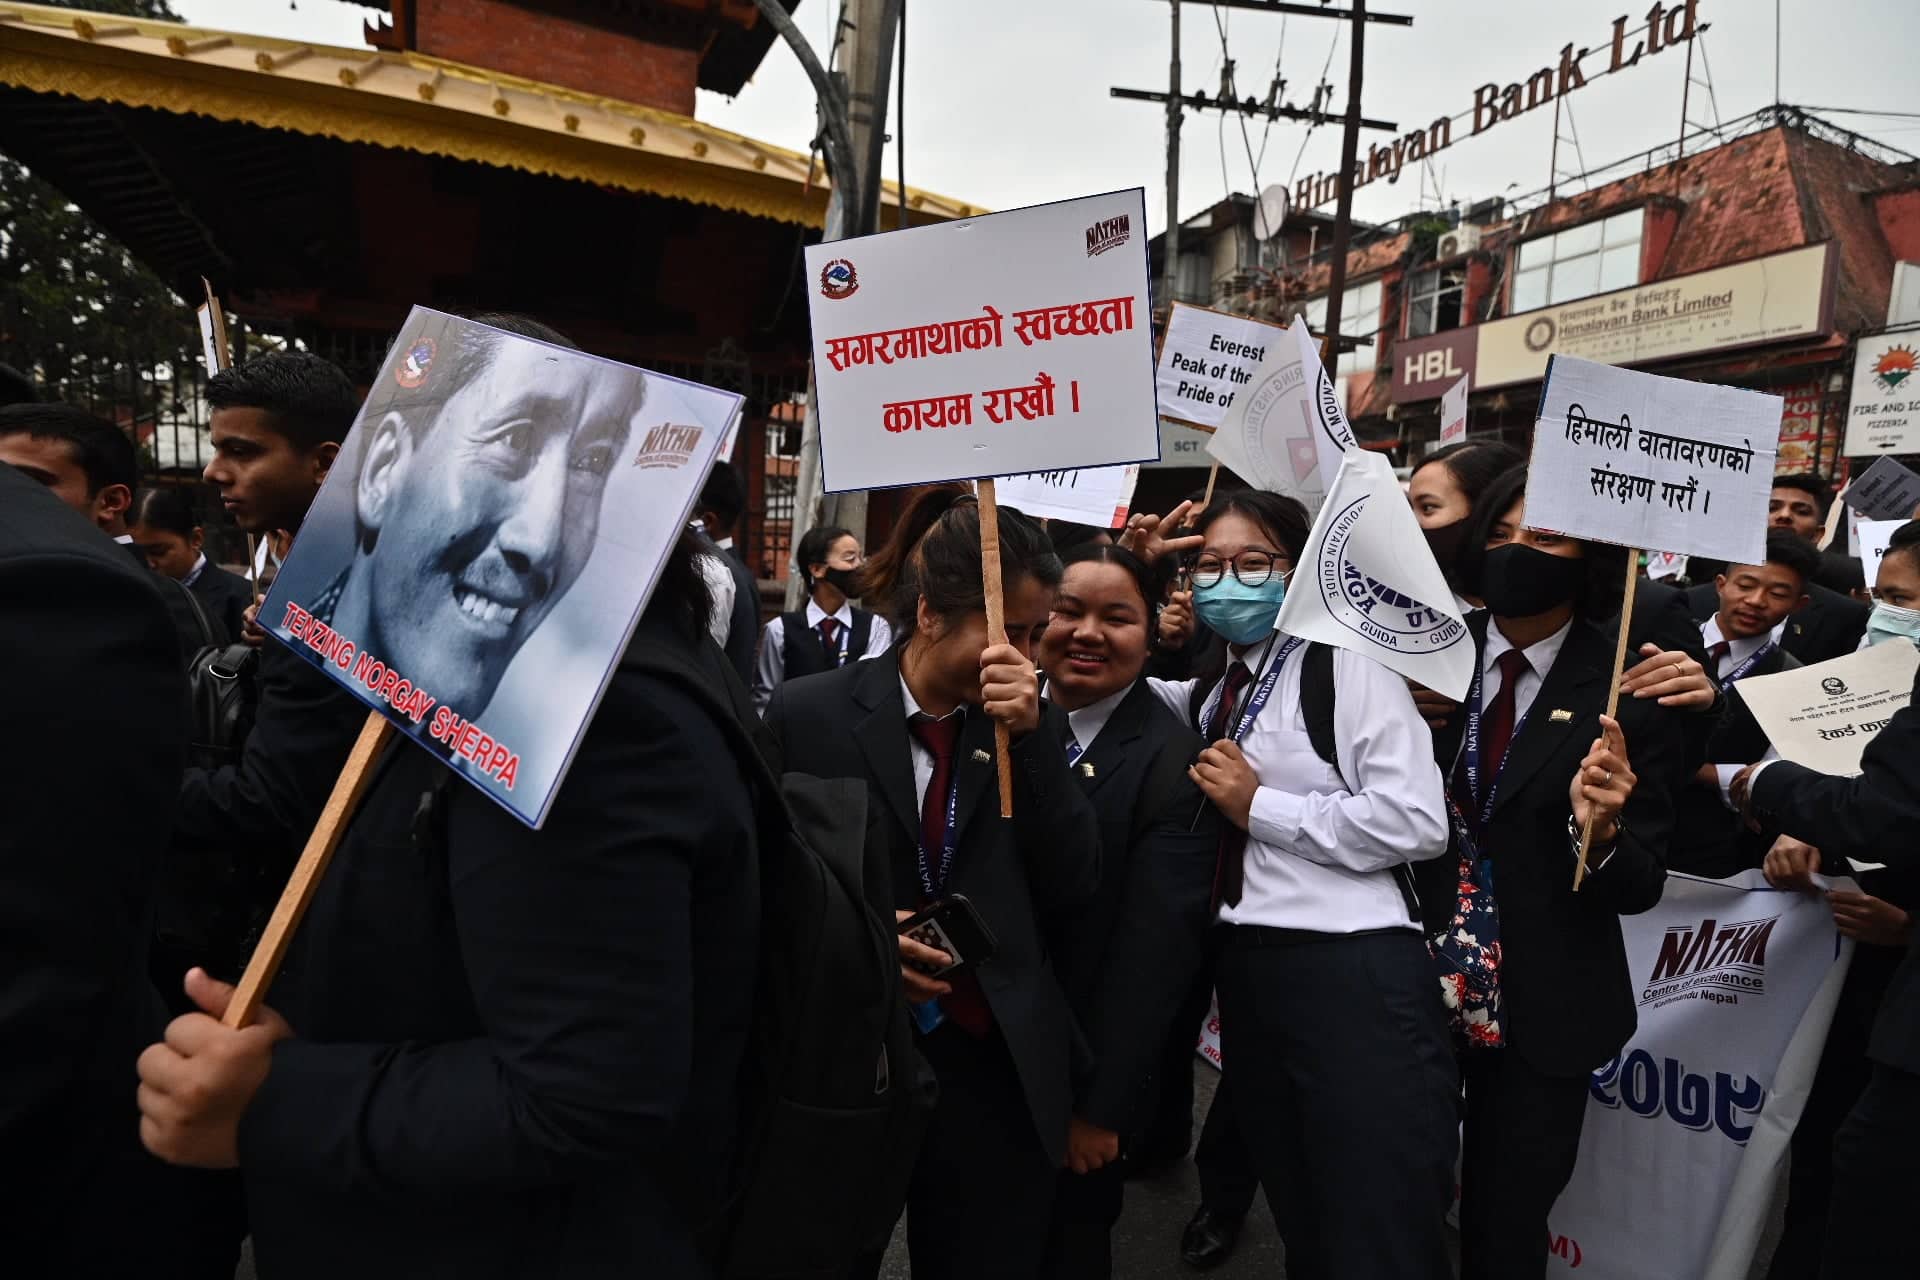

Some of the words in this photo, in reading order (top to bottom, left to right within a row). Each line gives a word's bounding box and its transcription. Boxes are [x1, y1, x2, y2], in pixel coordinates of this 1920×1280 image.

[1295, 116, 1452, 213] Himalayan
[1471, 42, 1589, 135] Bank
[1086, 214, 1129, 248] NATHM
[1559, 314, 1628, 337] Himalayan
[1631, 304, 1669, 323] Bank
[1673, 290, 1733, 314] Limited
[825, 305, 1003, 371] सगरमाथाको
[1012, 296, 1135, 346] स्वच्छता
[1209, 334, 1266, 362] Everest
[1171, 352, 1207, 375] Peak
[1211, 363, 1228, 380] of
[1404, 347, 1463, 385] HBL
[1177, 381, 1215, 403] Pride
[1218, 392, 1235, 408] of
[1853, 403, 1879, 416] FIRE
[1881, 402, 1905, 413] AND
[882, 393, 972, 433] कायम
[1867, 419, 1908, 429] PIZZERIA
[639, 422, 704, 454] NATHM
[1174, 440, 1199, 452] SCT
[1565, 403, 1633, 451] हिमाली
[1638, 429, 1755, 474] वातावरणको
[1590, 462, 1655, 504] संरक्षण
[1661, 475, 1699, 512] गरौं
[1327, 504, 1365, 556] OUNTAIN
[1324, 560, 1339, 599] GUIDE
[1344, 559, 1377, 614] MGA
[1359, 621, 1398, 647] GUIDA
[1406, 607, 1445, 628] UI
[1733, 657, 1755, 679] NATHM
[281, 601, 356, 671] TENZING
[352, 651, 435, 724] NORGAY
[429, 705, 521, 790] SHERPA
[1253, 672, 1278, 706] NATHM
[1468, 712, 1480, 751] NATHM
[1817, 724, 1857, 741] रेकर्ड
[1650, 919, 1778, 981] NATHM
[1643, 983, 1680, 1000] Centre
[1681, 979, 1693, 991] of
[1693, 971, 1764, 988] excellence
[1652, 990, 1699, 1009] Kathmandu
[1700, 990, 1738, 1005] Nepal
